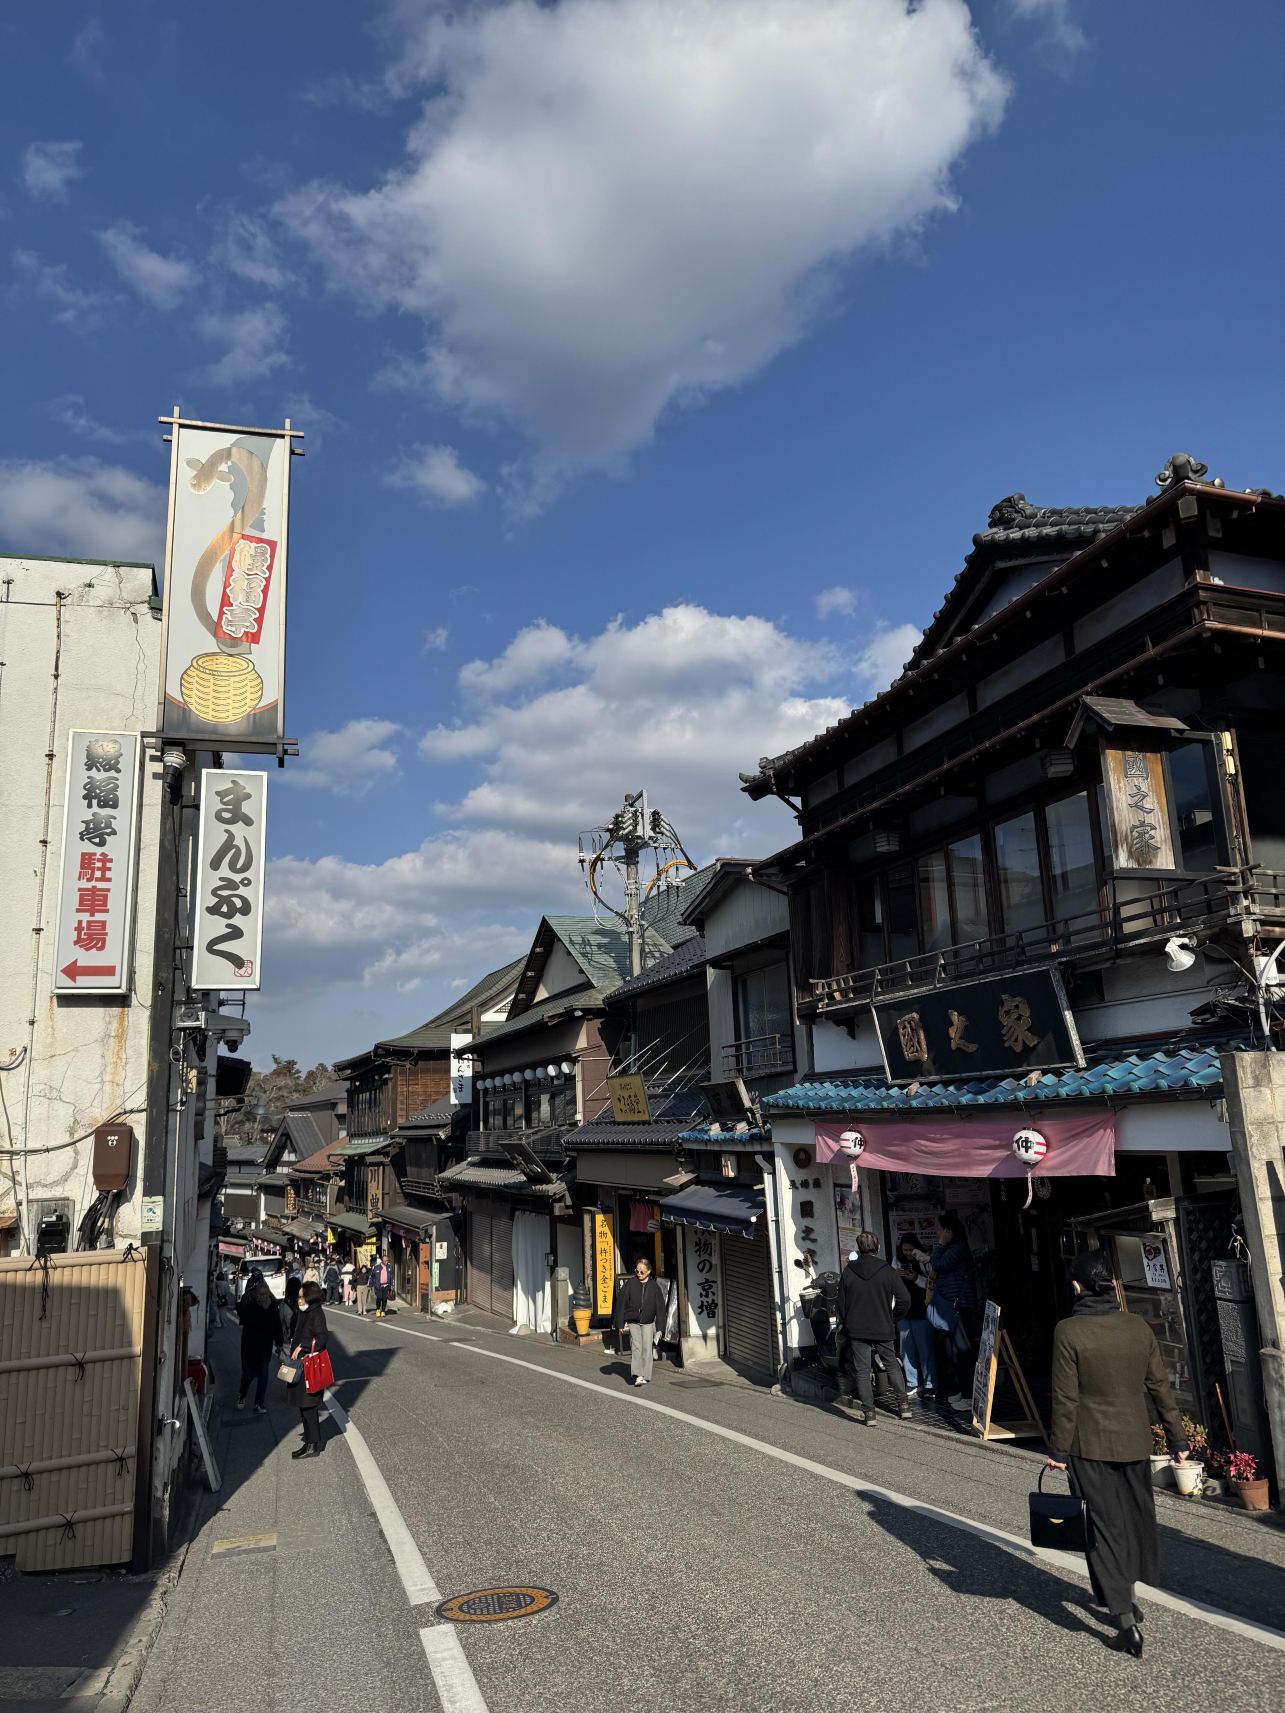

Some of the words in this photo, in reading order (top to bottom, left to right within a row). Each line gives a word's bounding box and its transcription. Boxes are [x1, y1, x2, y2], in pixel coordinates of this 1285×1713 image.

[73, 852, 113, 952] 駐車場
[205, 780, 254, 970] まんぷく
[851, 1136, 865, 1149] 仲
[1014, 1135, 1035, 1153] 仲
